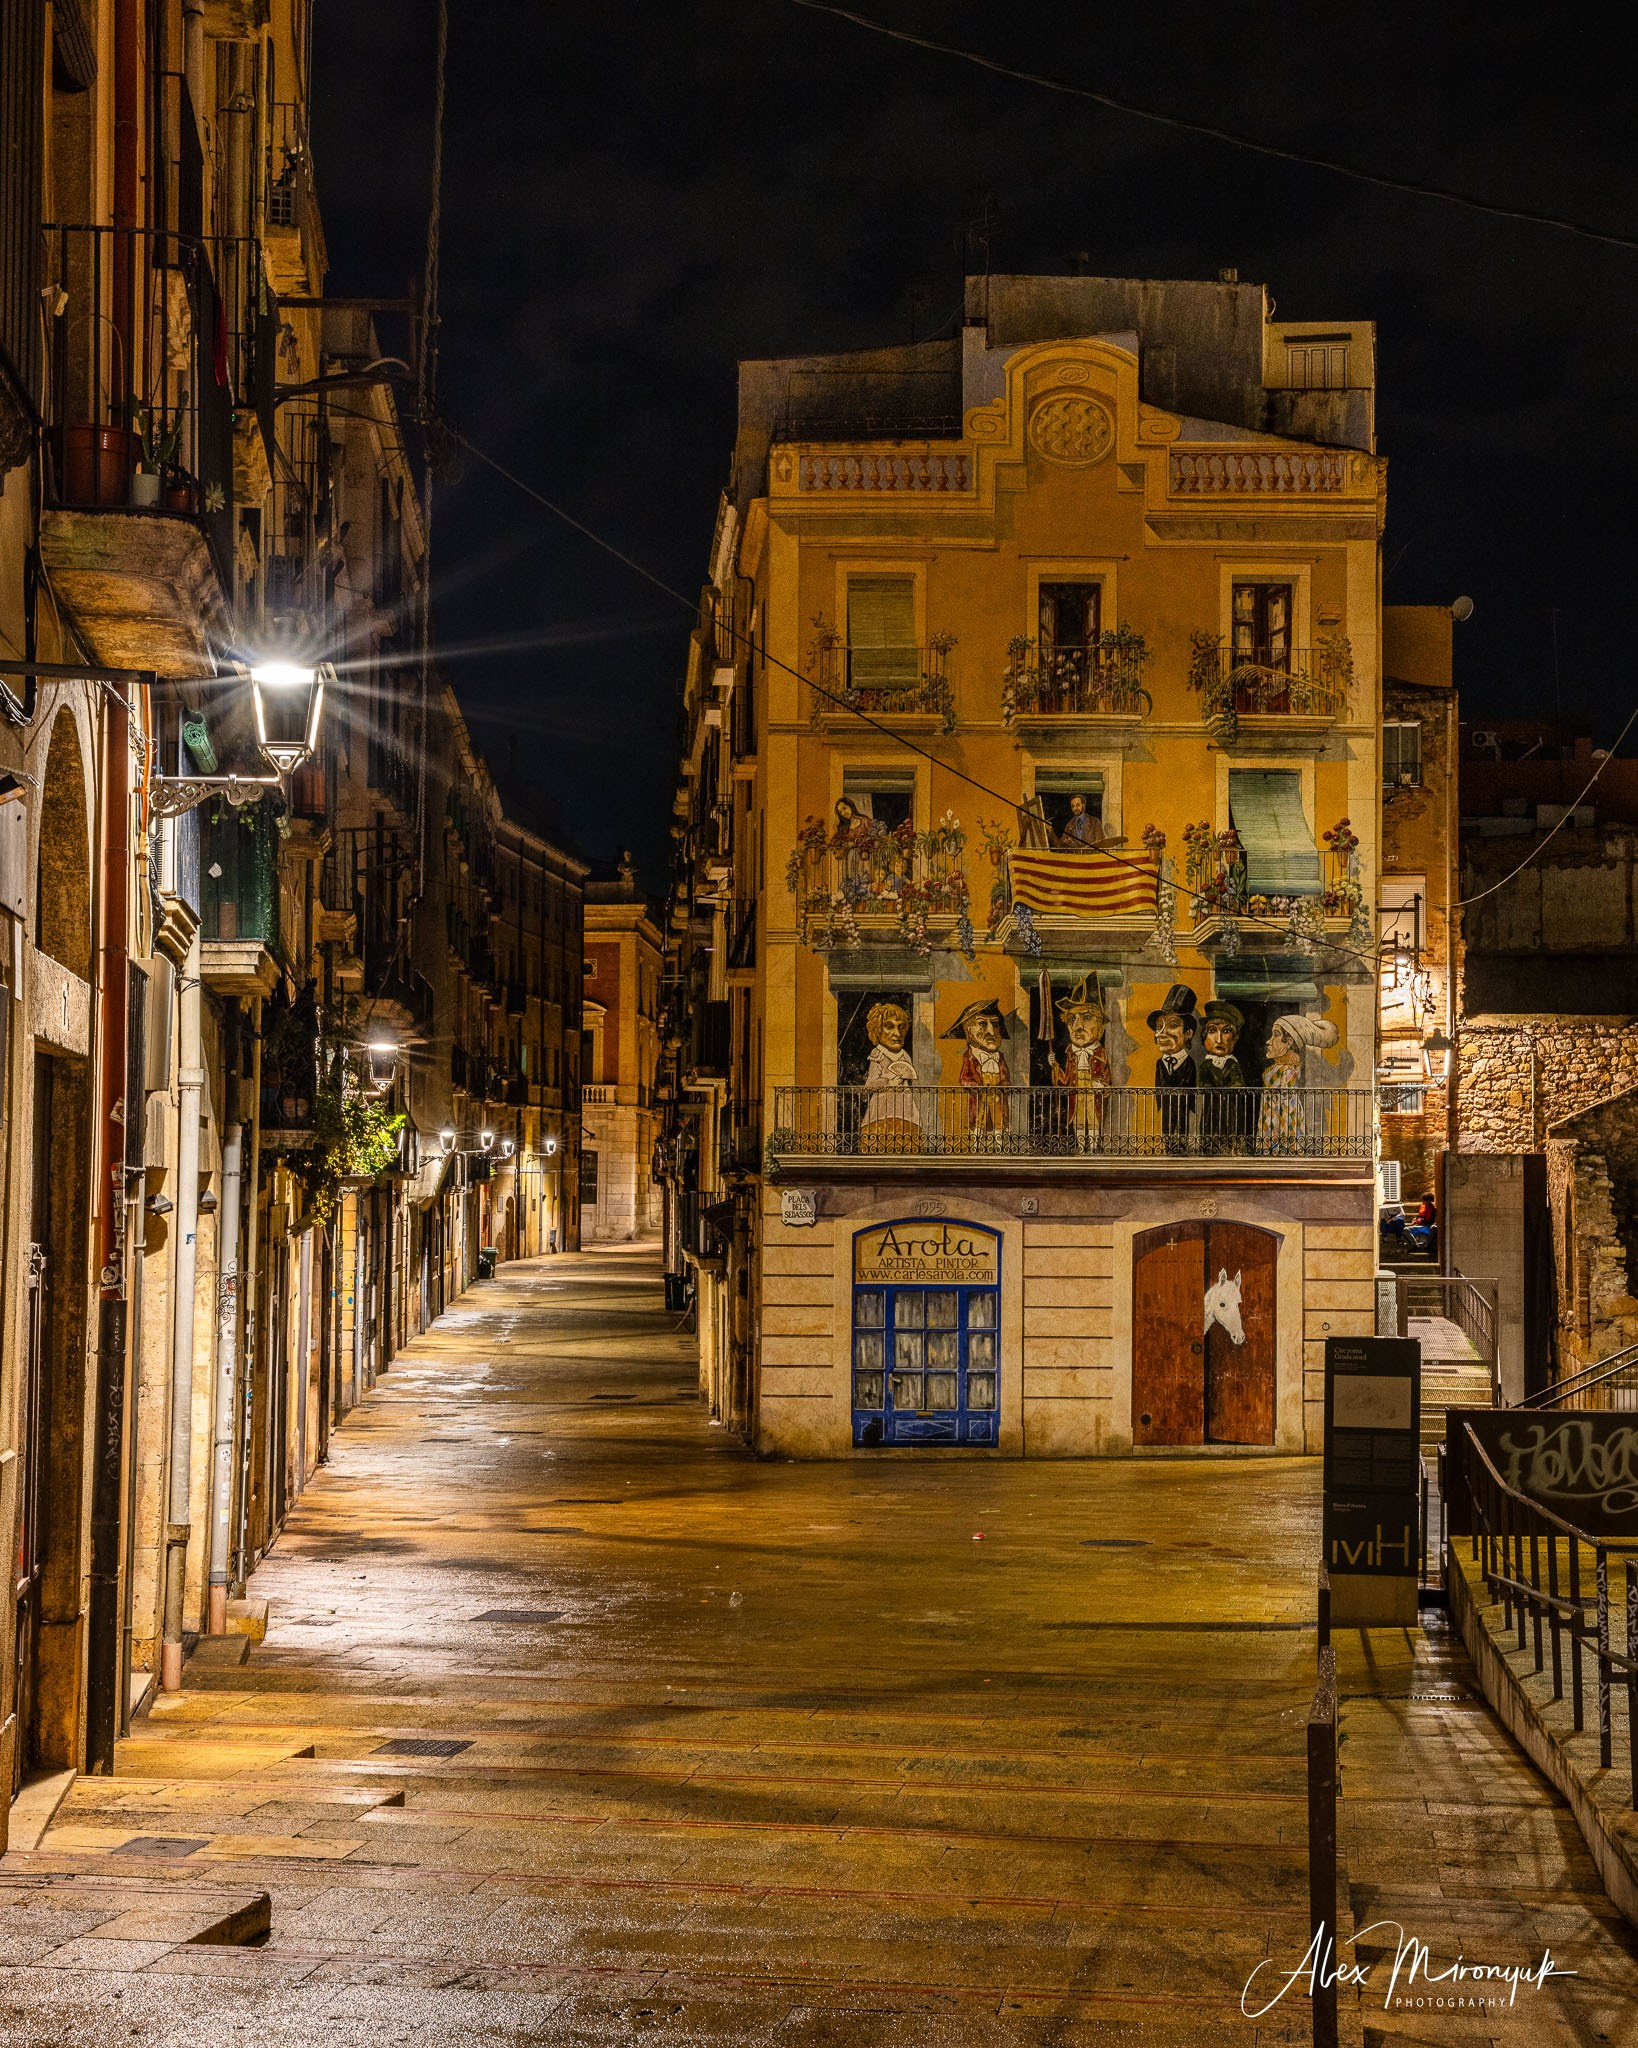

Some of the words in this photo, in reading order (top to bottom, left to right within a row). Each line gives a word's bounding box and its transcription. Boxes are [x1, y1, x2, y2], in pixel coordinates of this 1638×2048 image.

[792, 1203, 808, 1211] DELS
[1027, 1200, 1034, 1211] 2
[784, 1211, 814, 1219] SEDASSOS
[876, 1225, 990, 1257] Arola
[878, 1257, 926, 1268] ARTISTA
[936, 1257, 979, 1268] PINTOR
[857, 1269, 993, 1280] www.carlesarola.com
